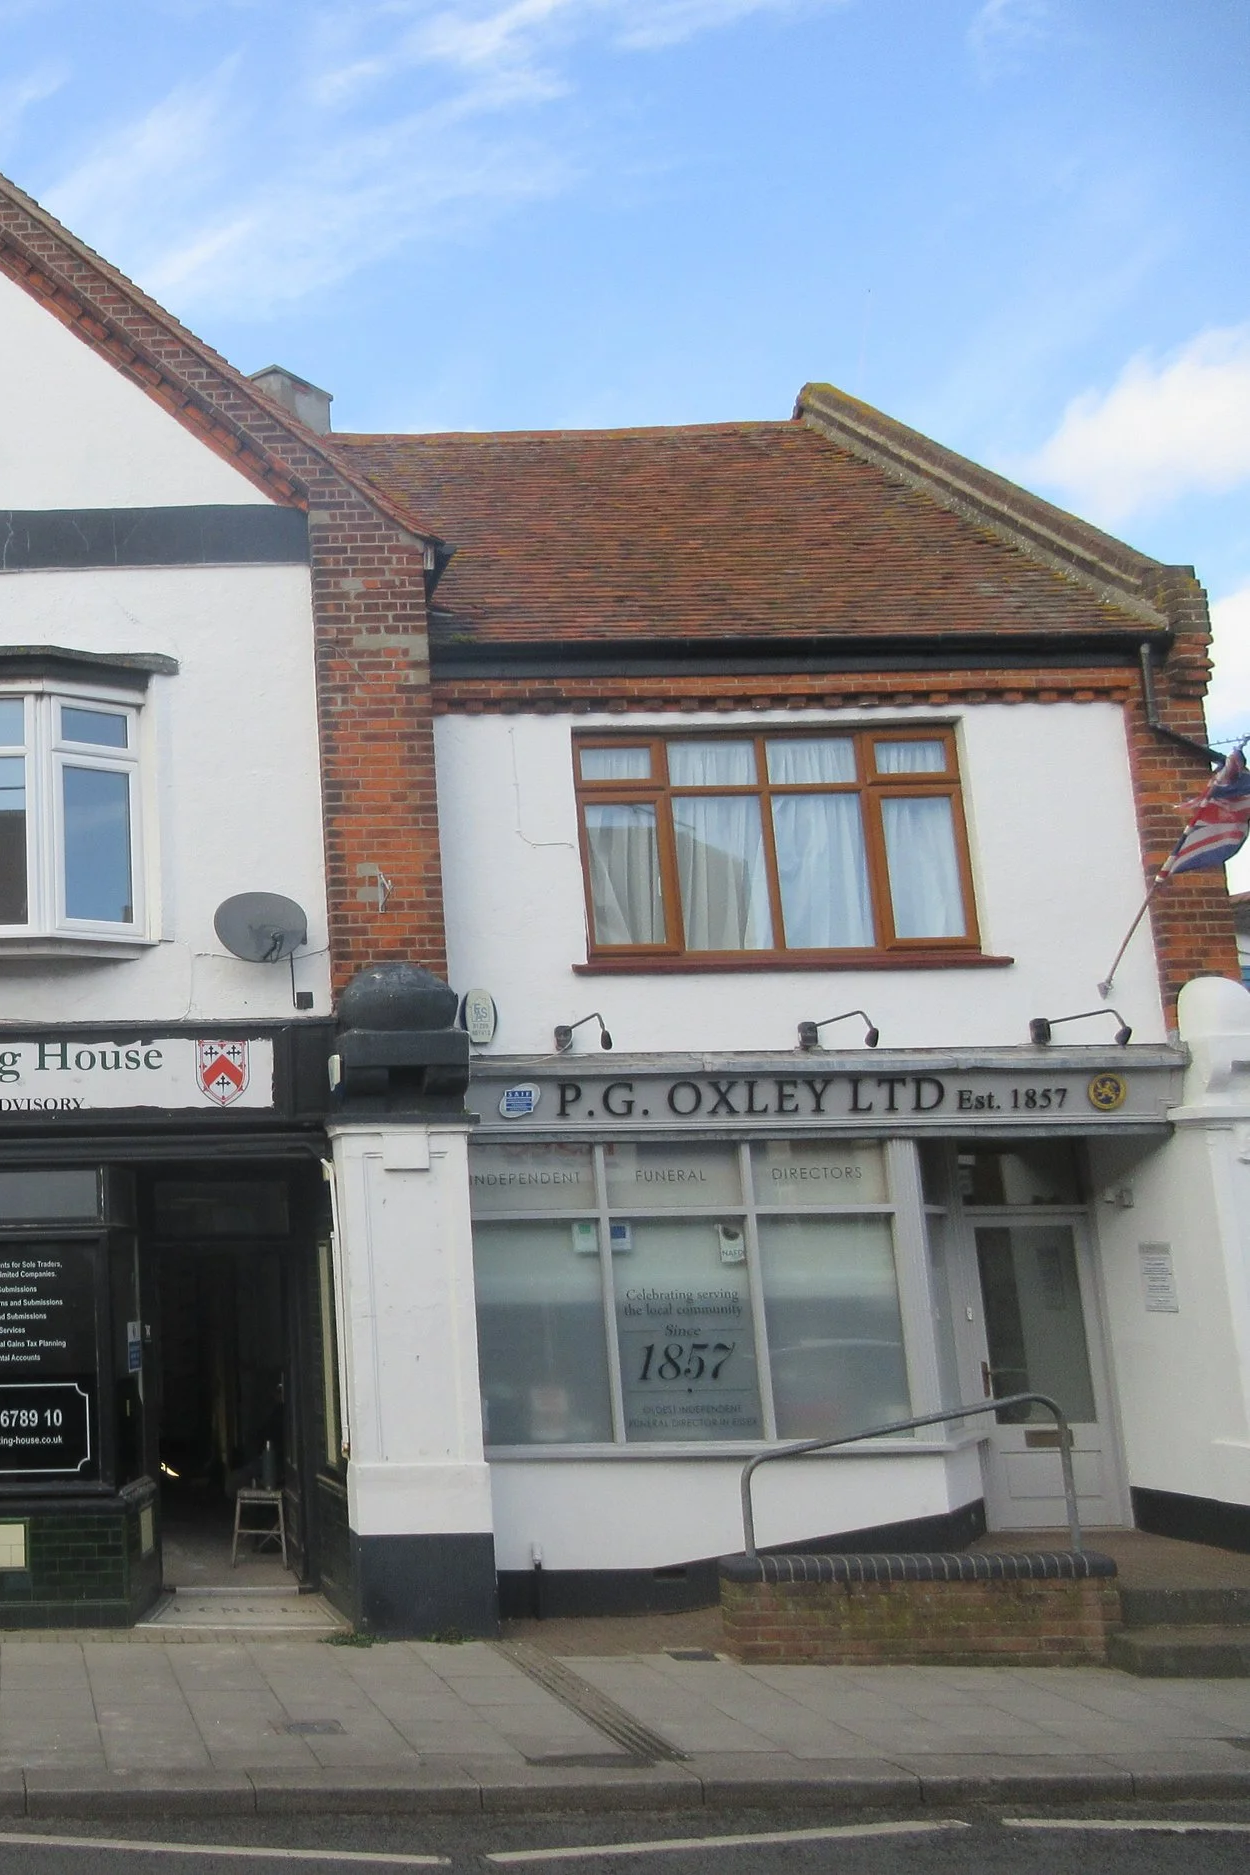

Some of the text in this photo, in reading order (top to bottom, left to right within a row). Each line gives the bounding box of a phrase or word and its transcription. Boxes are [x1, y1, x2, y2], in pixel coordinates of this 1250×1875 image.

[35, 1041, 162, 1071] House
[667, 1079, 834, 1115] OXLEY
[848, 1078, 944, 1112] LTD
[957, 1089, 1000, 1110] Est.
[1011, 1088, 1067, 1109] 1857
[636, 1169, 706, 1182] FUNERAL
[772, 1167, 862, 1180] DIRECTORS
[21, 1271, 56, 1279] Companies.
[626, 1289, 738, 1303] Celebrating serving
[625, 1303, 743, 1317] the local community
[665, 1324, 701, 1336] Since
[39, 1340, 66, 1348] Planning
[639, 1342, 736, 1380] 1857
[0, 1410, 38, 1427] 6789
[44, 1409, 62, 1426] 10
